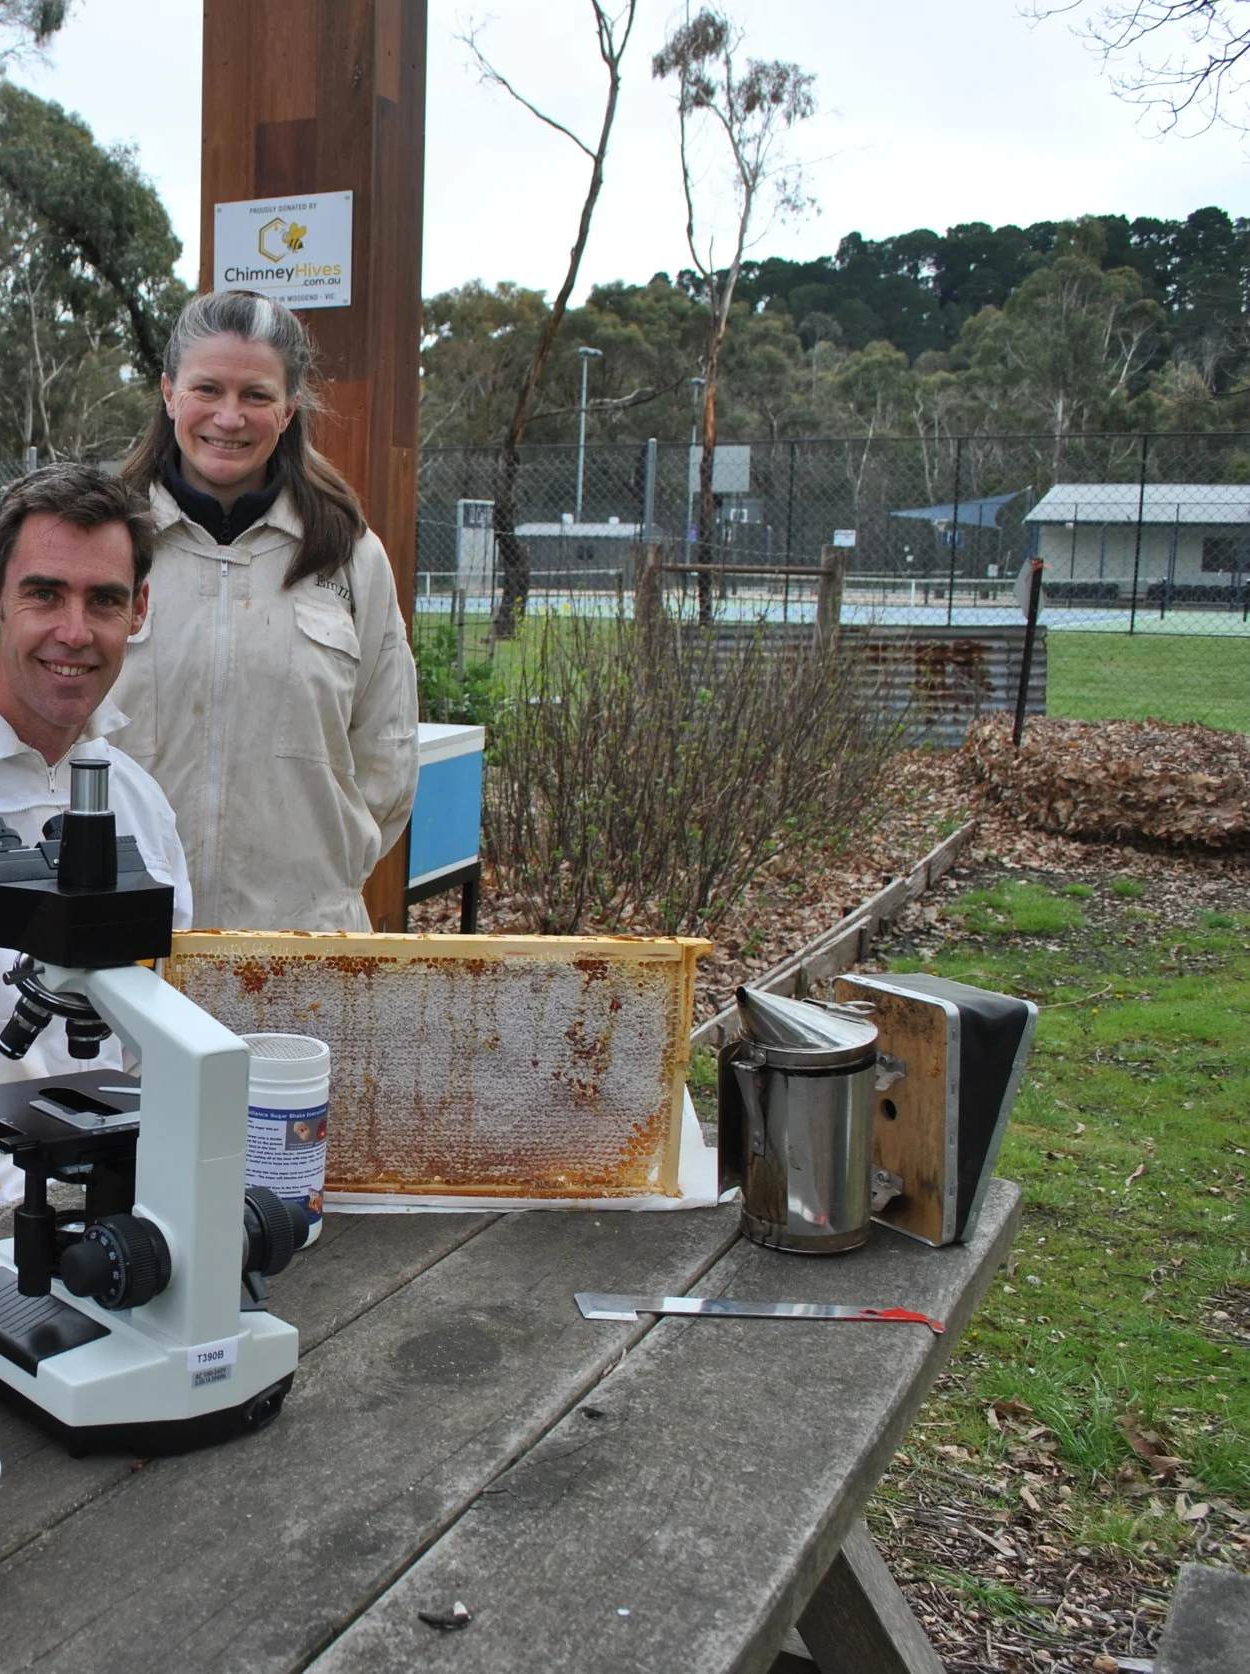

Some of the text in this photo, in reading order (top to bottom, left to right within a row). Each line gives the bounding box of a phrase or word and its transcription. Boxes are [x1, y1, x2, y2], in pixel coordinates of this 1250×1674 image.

[277, 203, 307, 213] DONATED
[302, 276, 341, 287] .com.au
[287, 294, 318, 302] WOODEND
[197, 1349, 225, 1364] T390B
